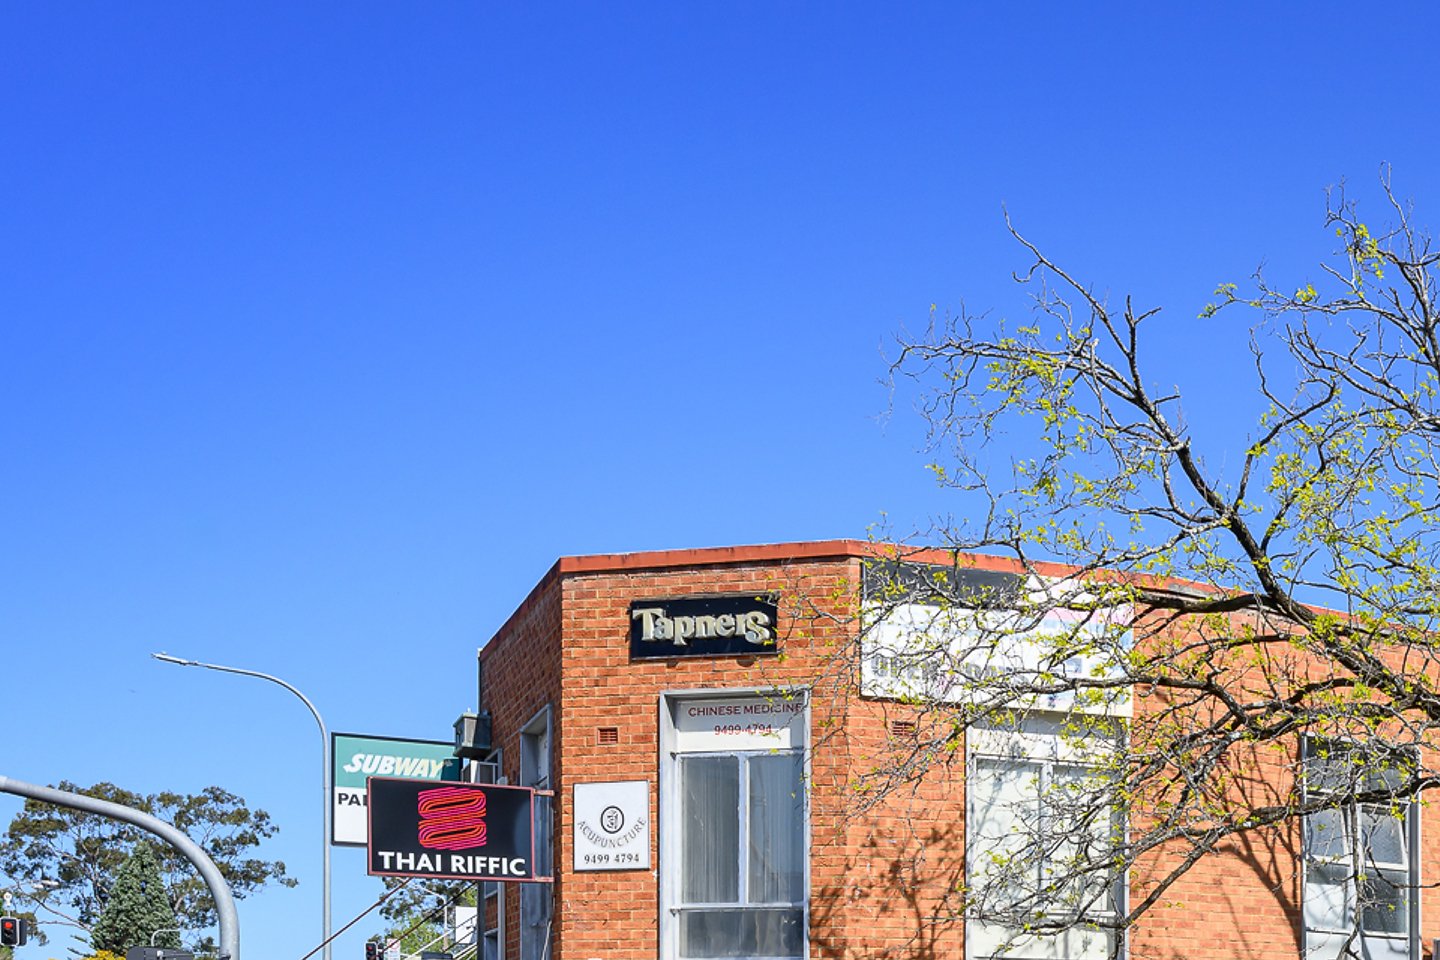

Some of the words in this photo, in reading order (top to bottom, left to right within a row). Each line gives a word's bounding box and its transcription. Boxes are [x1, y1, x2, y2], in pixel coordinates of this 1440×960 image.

[632, 608, 771, 646] Tapners
[688, 702, 742, 717] CHINESE
[743, 702, 803, 715] MEDICINE
[343, 753, 446, 779] SUBWAY
[577, 817, 647, 848] ACUPUNCTURE
[378, 851, 443, 873] THAI
[450, 855, 527, 876] RIFFIC
[584, 854, 610, 865] 9499
[614, 852, 640, 863] 4794
